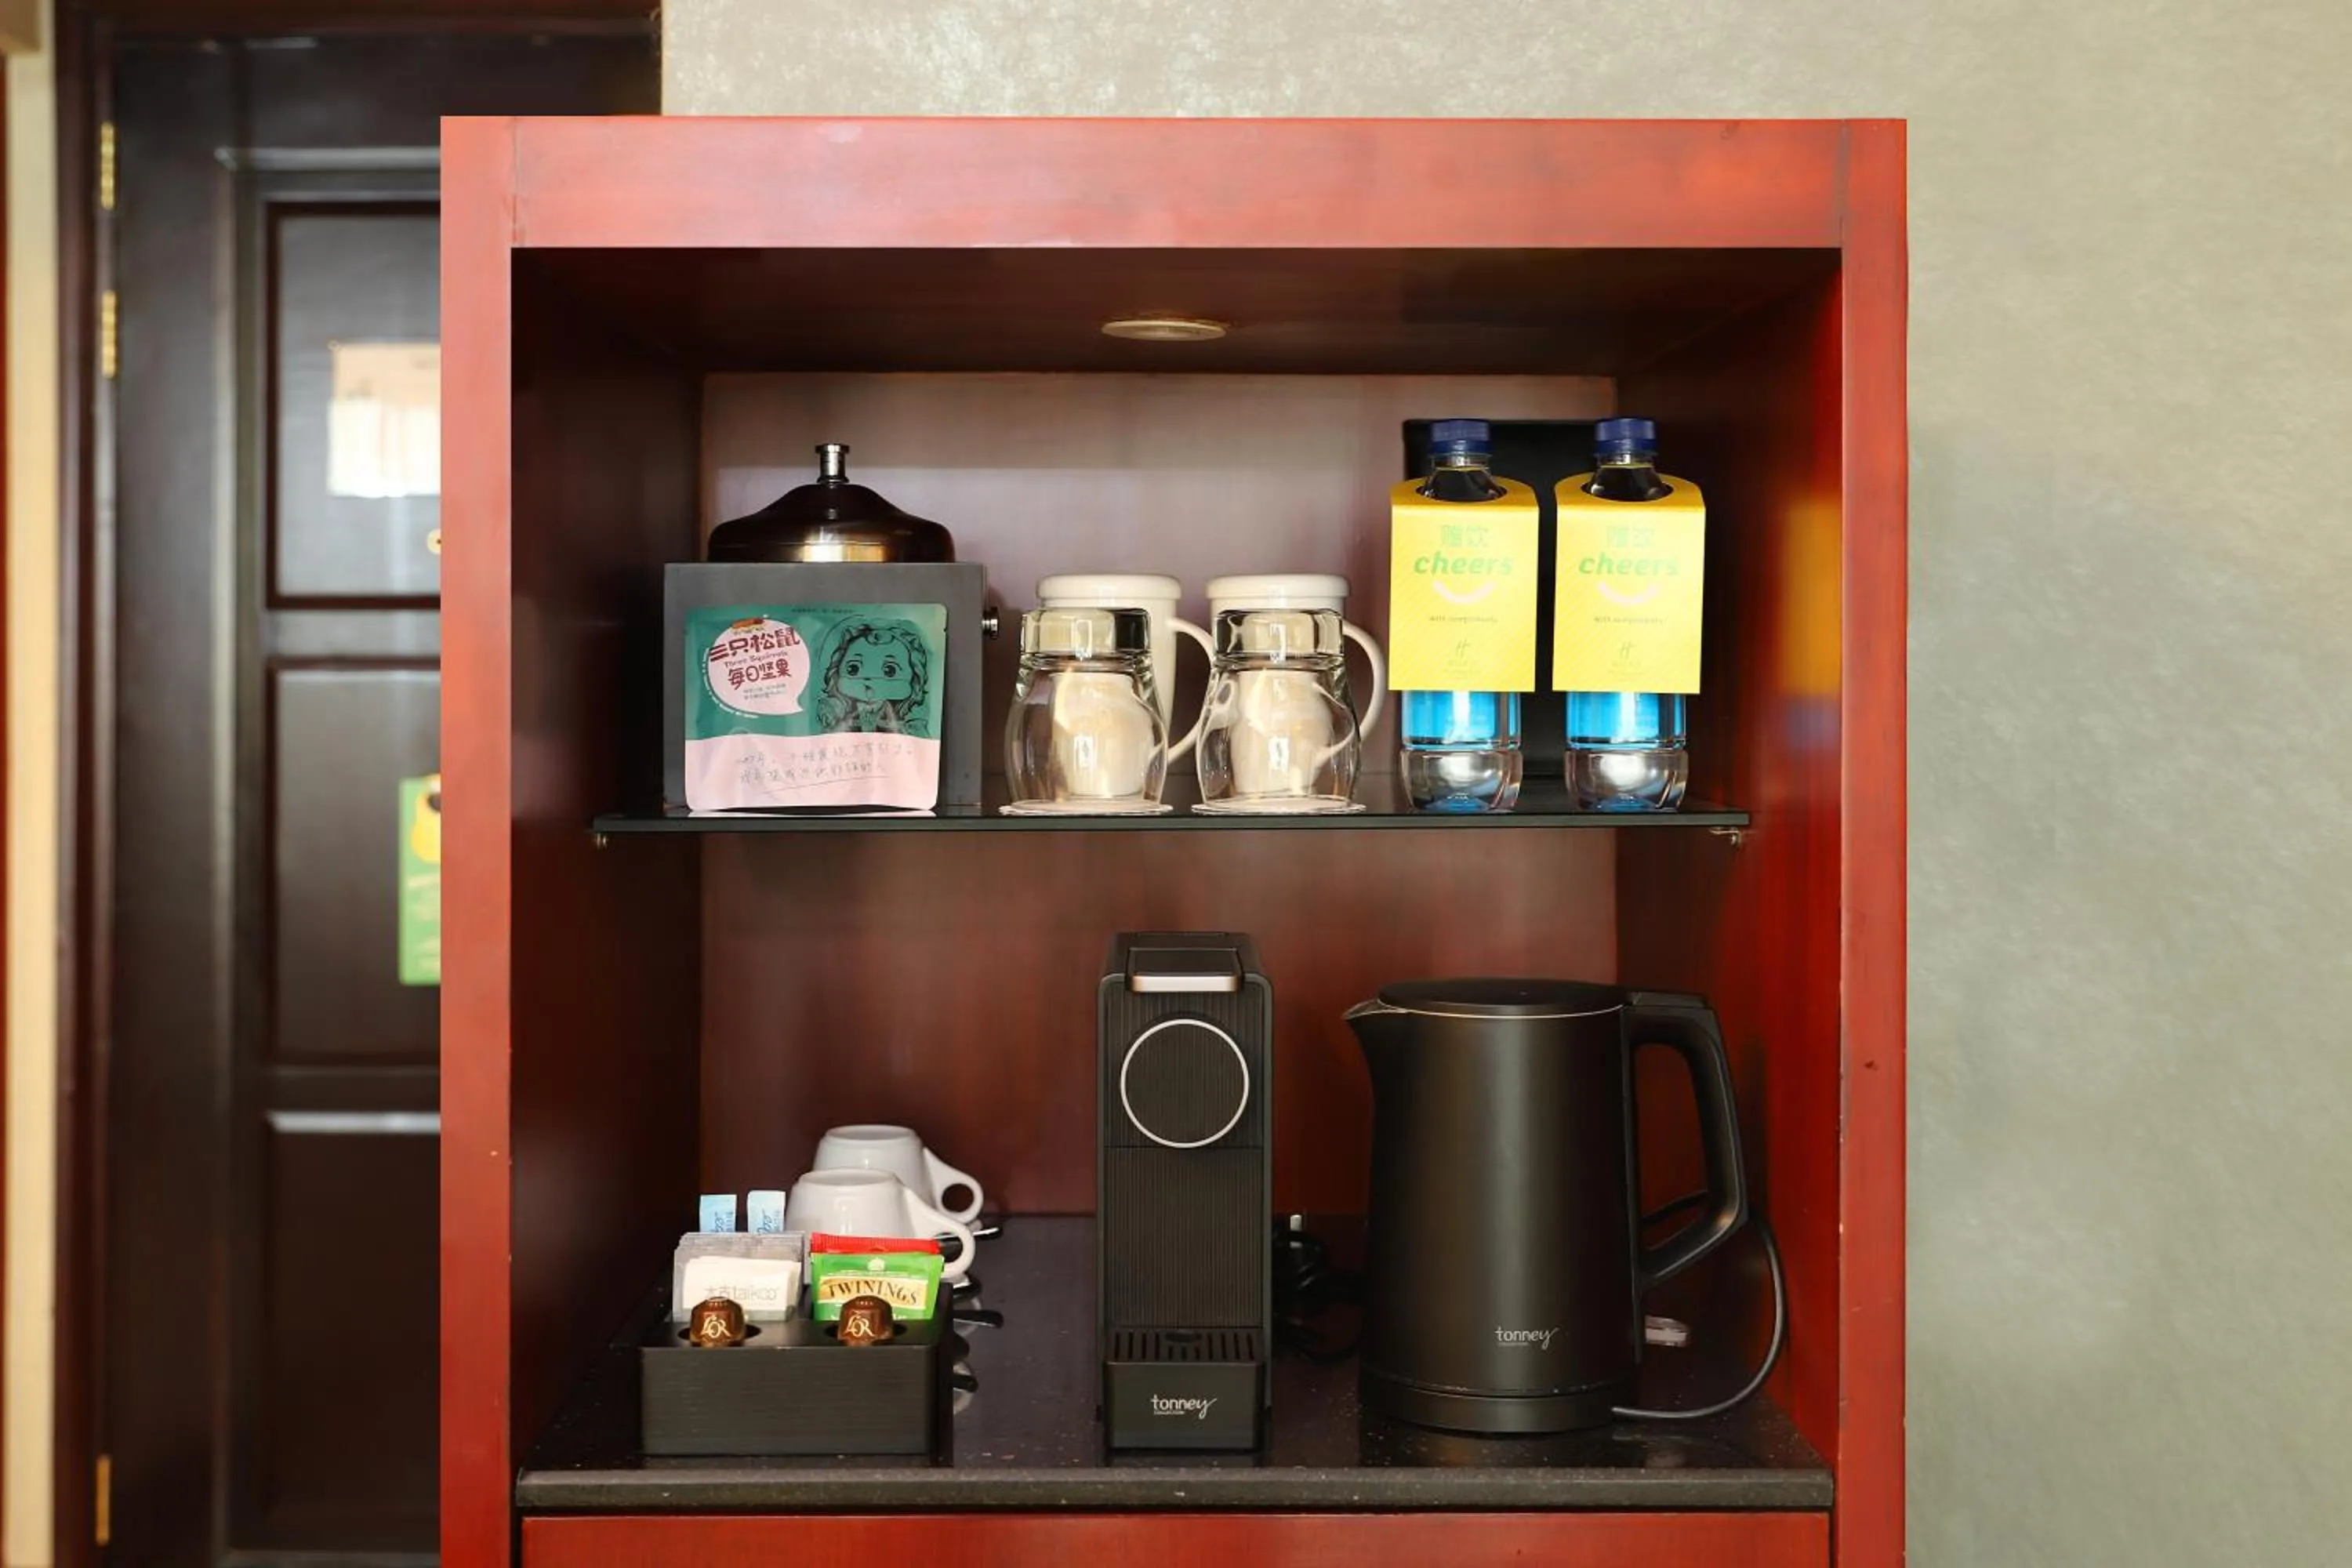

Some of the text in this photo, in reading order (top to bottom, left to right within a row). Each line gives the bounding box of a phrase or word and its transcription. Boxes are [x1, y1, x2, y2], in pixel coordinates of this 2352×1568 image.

[1414, 550, 1515, 576] cheers
[1578, 552, 1679, 576] cheers
[709, 626, 800, 662] 三只松鼠
[728, 659, 792, 691] 每日坚果
[829, 1279, 917, 1305] TWININGS
[1494, 1325, 1560, 1350] tonney
[1150, 1393, 1218, 1420] tonney
